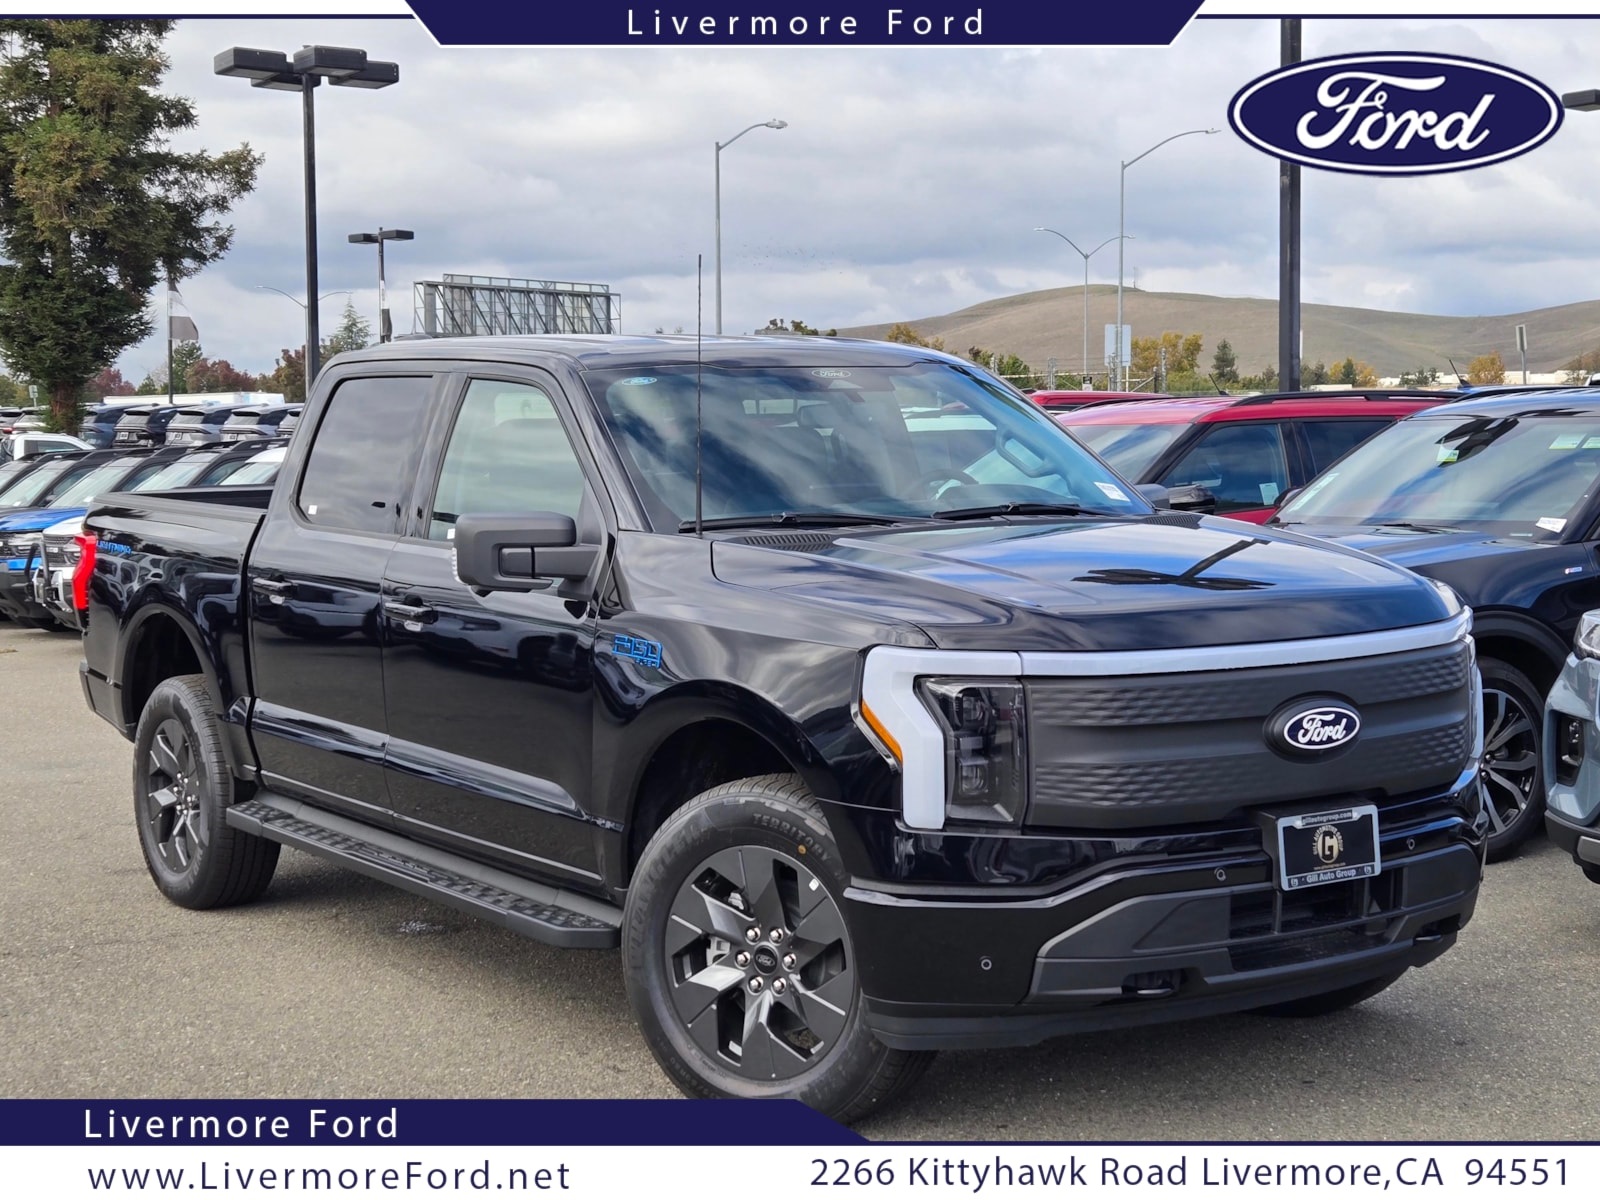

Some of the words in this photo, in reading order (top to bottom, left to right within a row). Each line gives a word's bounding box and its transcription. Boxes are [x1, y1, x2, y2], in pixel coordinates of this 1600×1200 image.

[1297, 713, 1347, 744] Ford
[752, 813, 832, 861] TERRITORY
[1306, 874, 1318, 883] Gill
[1318, 872, 1335, 881] Auto
[1336, 869, 1356, 878] Group
